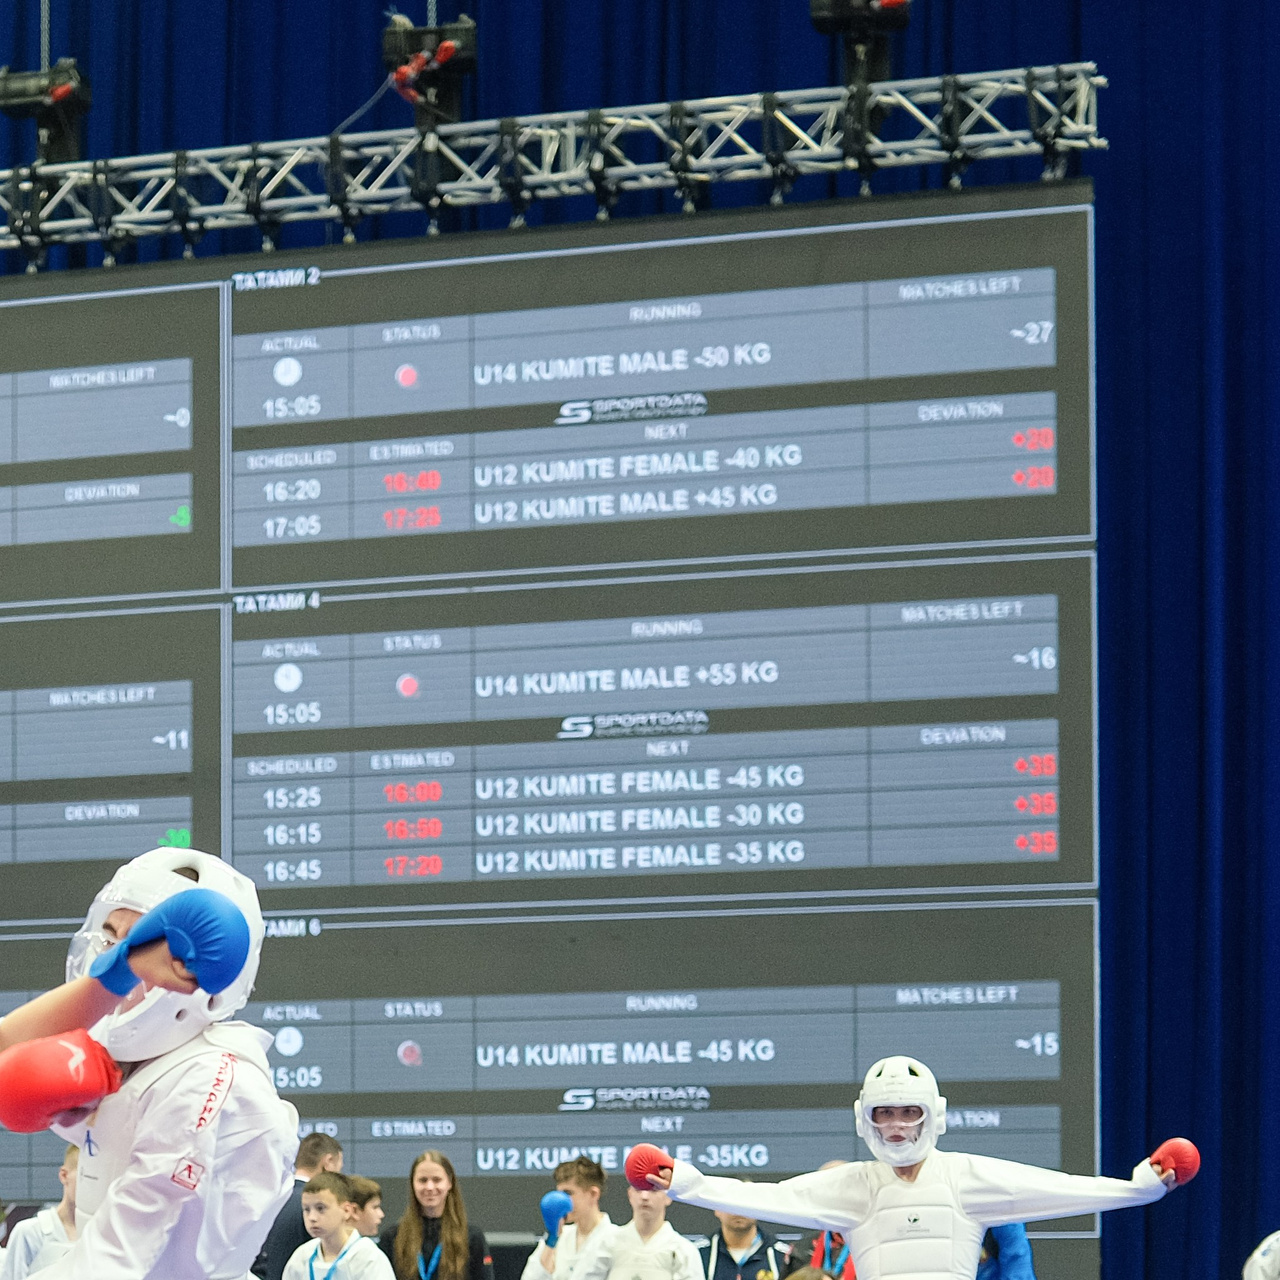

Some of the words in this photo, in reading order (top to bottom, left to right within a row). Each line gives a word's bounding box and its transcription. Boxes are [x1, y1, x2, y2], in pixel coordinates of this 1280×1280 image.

[307, 266, 320, 285] 2
[979, 276, 1021, 295] LEFT
[629, 302, 702, 322] RUNNING
[382, 324, 441, 342] STATUS
[474, 362, 517, 385] U14
[522, 355, 615, 381] KUMITE
[619, 349, 688, 373] MALE
[694, 346, 729, 367] -50
[734, 342, 771, 364] KG
[262, 395, 321, 418] 15:05
[918, 401, 1004, 421] DEVIATION
[644, 423, 688, 439] NEXT
[474, 464, 518, 487] U12
[522, 457, 615, 483] KUMITE
[619, 449, 719, 476] FEMALE
[726, 446, 759, 468] -40
[765, 444, 802, 466] KG
[264, 478, 321, 501] 16:20
[474, 501, 518, 524] U12
[522, 494, 615, 520] KUMITE
[619, 489, 689, 513] MALE
[694, 486, 735, 508] +45
[740, 483, 777, 505] KG
[264, 515, 321, 538] 17:05
[308, 591, 320, 608] 4
[982, 602, 1024, 620] LEFT
[631, 619, 703, 638] RUNNING
[262, 642, 320, 658] ACTUAL
[383, 634, 442, 651] STATUS
[475, 675, 518, 698] U14
[522, 669, 616, 695] KUMITE
[620, 665, 689, 690] MALE
[695, 663, 736, 686] +55
[741, 661, 778, 683] KG
[263, 702, 320, 725] 15:05
[920, 726, 1006, 745] DEVIATION
[246, 756, 337, 776] SCHEDULED
[370, 752, 454, 770] ESTIMATED
[475, 777, 518, 799] U12
[524, 773, 616, 797] KUMITE
[621, 768, 720, 793] FEMALE
[727, 767, 762, 789] -45
[767, 764, 804, 788] KG
[264, 786, 321, 809] 15:25
[475, 815, 518, 836] U12
[524, 810, 616, 835] KUMITE
[621, 806, 720, 831] FEMALE
[727, 804, 762, 826] -30
[767, 802, 804, 825] KG
[264, 822, 321, 845] 16:15
[475, 852, 518, 874] U12
[524, 848, 616, 872] KUMITE
[621, 843, 720, 869] FEMALE
[727, 842, 762, 863] -35
[767, 840, 805, 862] KG
[264, 859, 321, 882] 16:45
[626, 994, 698, 1011] RUNNING
[976, 986, 1018, 1003] LEFT
[262, 1006, 322, 1021] ACTUAL
[384, 1002, 442, 1018] STATUS
[477, 1045, 519, 1067] U14
[525, 1042, 617, 1065] KUMITE
[623, 1041, 691, 1064] MALE
[698, 1039, 732, 1062] -45
[738, 1038, 774, 1061] KG
[372, 1120, 456, 1136] ESTIMATED
[641, 1116, 684, 1132] NEXT
[477, 1148, 520, 1171] U12
